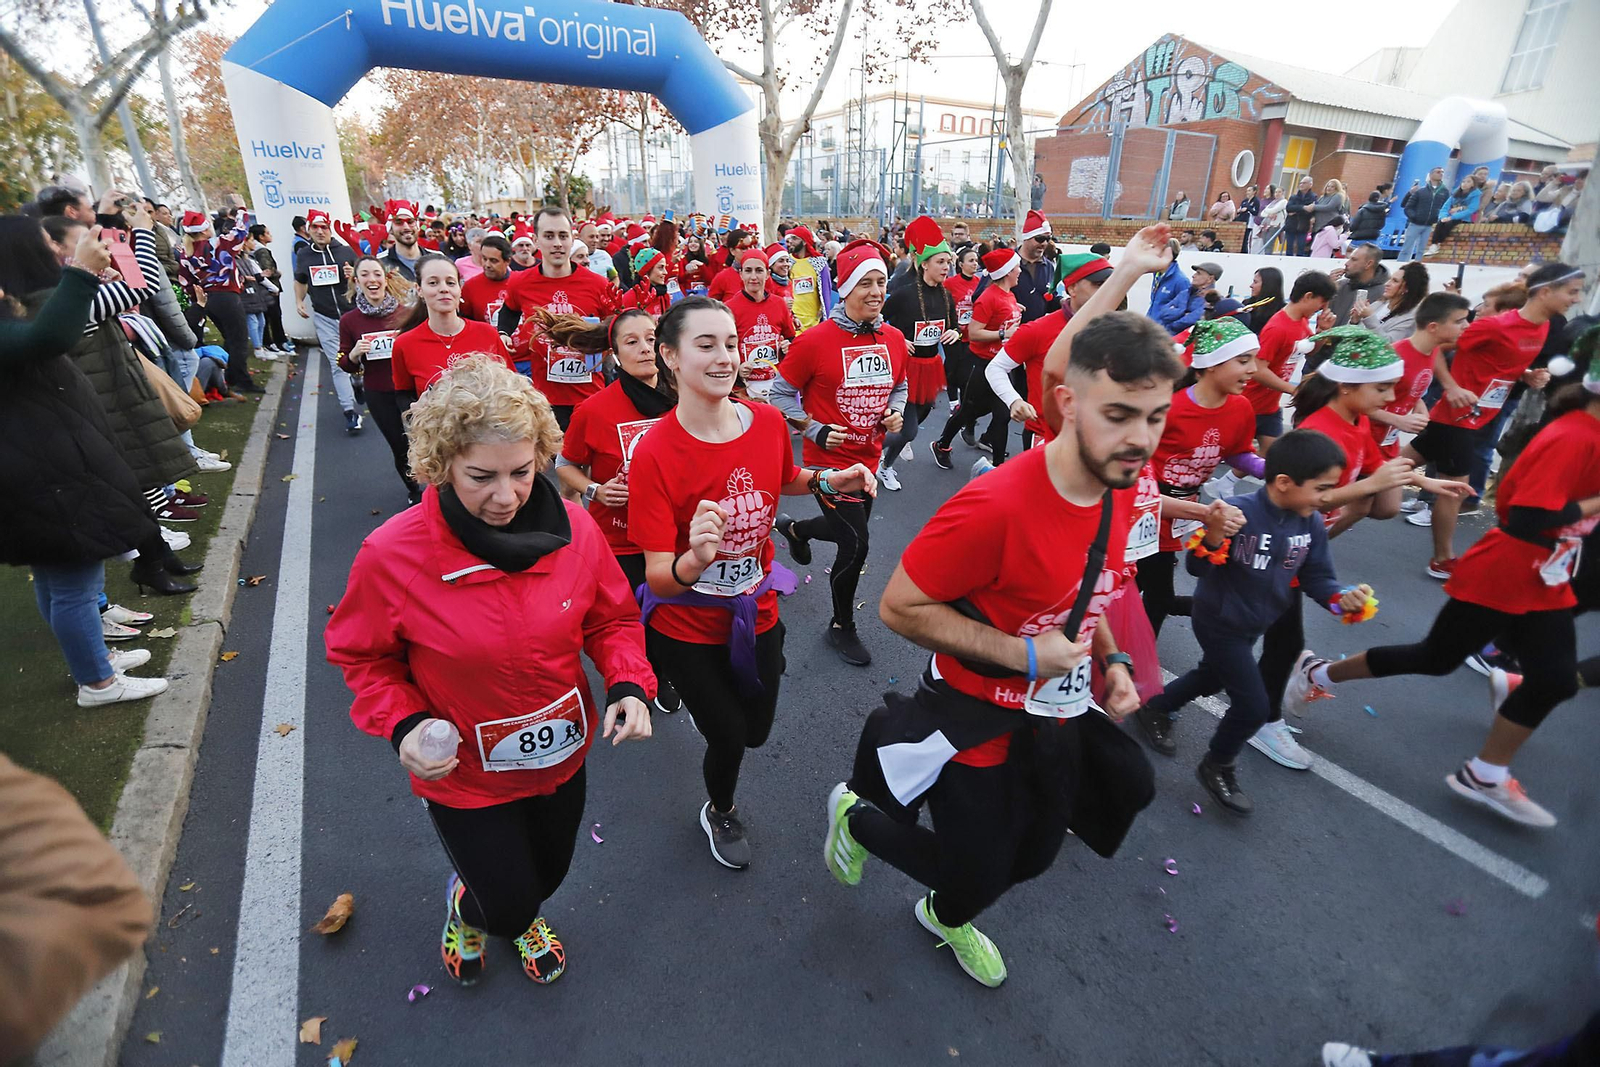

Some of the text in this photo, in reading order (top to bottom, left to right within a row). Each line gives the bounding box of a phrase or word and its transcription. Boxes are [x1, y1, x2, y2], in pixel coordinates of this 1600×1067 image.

[380, 0, 657, 60] Huelva original
[251, 140, 324, 160] Huelva
[715, 162, 758, 176] Huelva
[288, 196, 331, 204] HUELVA
[923, 327, 938, 338] 466
[374, 338, 393, 350] 217
[757, 348, 768, 359] 62
[560, 360, 582, 373] 147
[858, 356, 881, 373] 179
[716, 557, 753, 582] 133
[518, 725, 555, 754] 89
